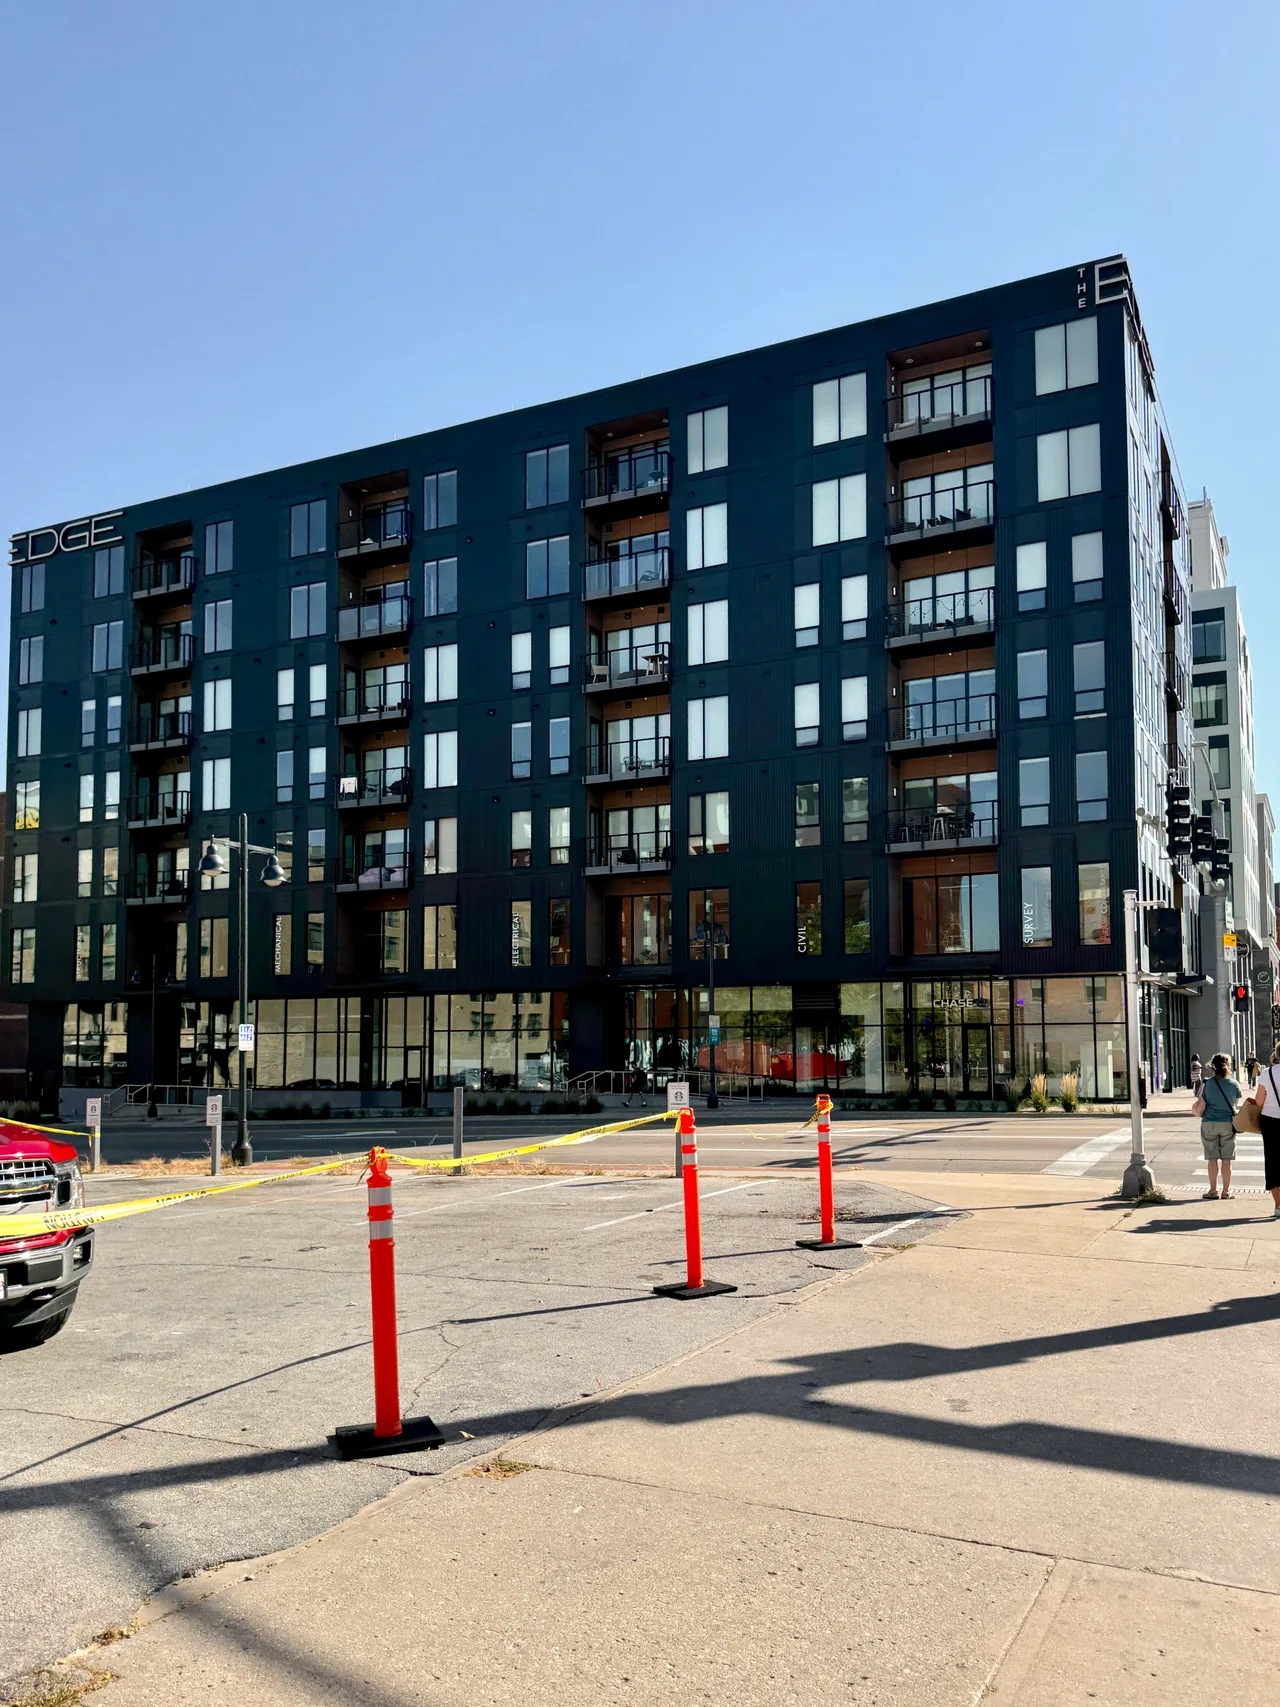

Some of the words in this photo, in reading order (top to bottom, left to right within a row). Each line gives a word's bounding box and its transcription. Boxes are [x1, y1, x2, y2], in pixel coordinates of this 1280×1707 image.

[1077, 267, 1086, 309] THE
[8, 511, 124, 566] EDGE
[274, 915, 282, 973] MECHANICAL
[511, 912, 520, 964] ELECTRICAL
[797, 925, 807, 953] CIVIL
[1023, 902, 1034, 944] SURVEY
[933, 998, 974, 1008] CHASE
